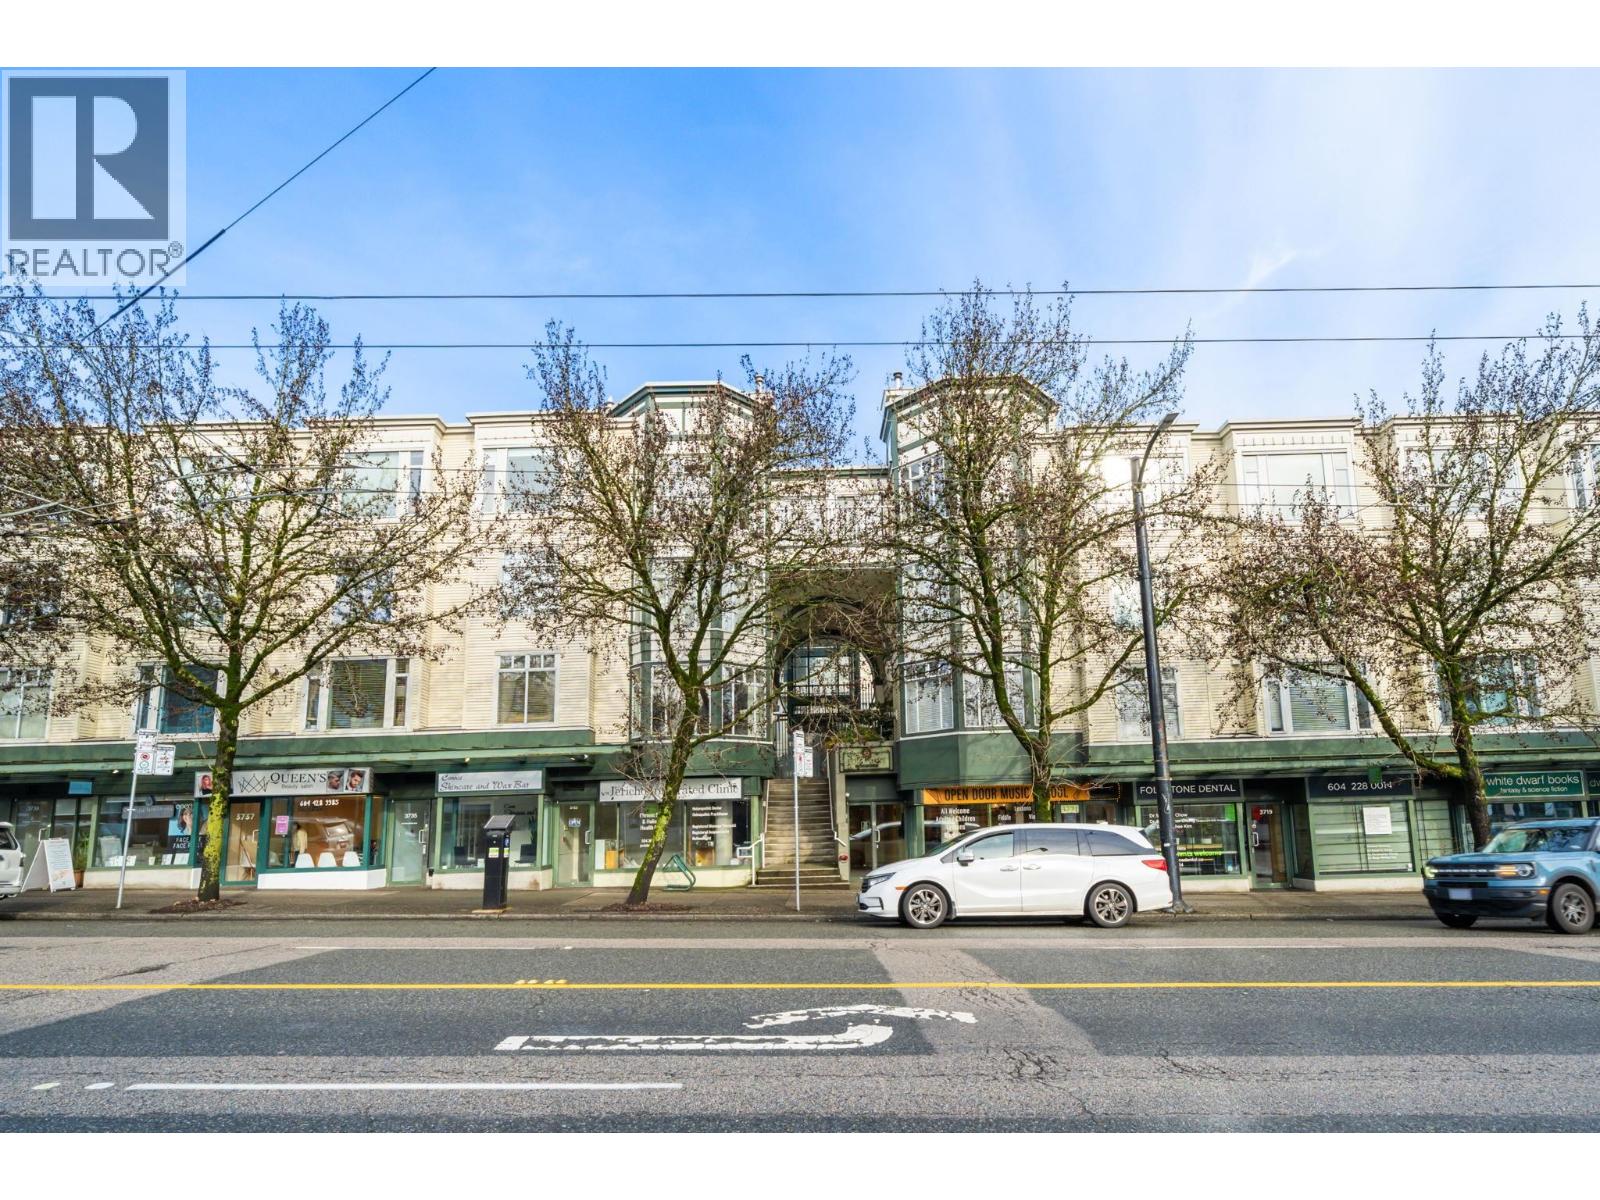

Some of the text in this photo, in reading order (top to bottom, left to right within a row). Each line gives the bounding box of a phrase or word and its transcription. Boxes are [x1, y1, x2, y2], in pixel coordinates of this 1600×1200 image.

[270, 772, 327, 784] QUEEN'S
[1486, 774, 1580, 786] white dwarf books
[492, 780, 512, 789] Wax
[513, 780, 529, 788] Bar
[707, 782, 738, 794] Clinic
[1140, 784, 1236, 794] FOLTONE DENTAL
[1327, 781, 1393, 791] 604 228 0014
[944, 788, 968, 801] OPEN
[972, 787, 997, 800] DOOR
[1000, 786, 1030, 799] MUSIC
